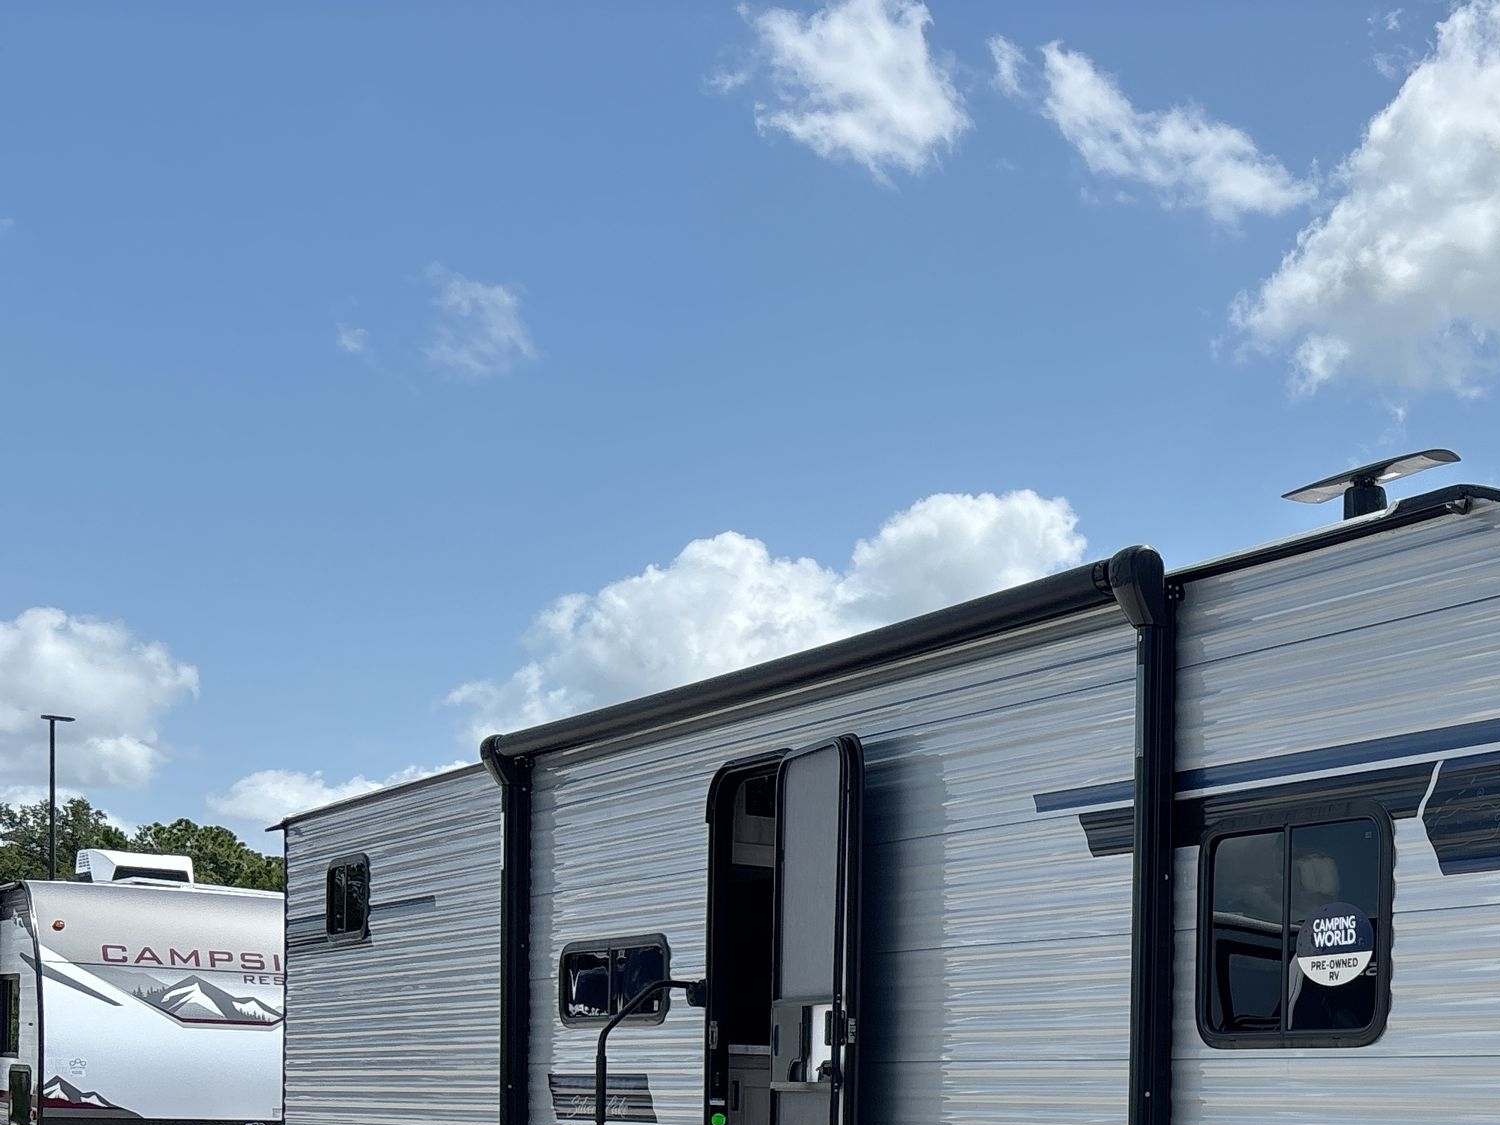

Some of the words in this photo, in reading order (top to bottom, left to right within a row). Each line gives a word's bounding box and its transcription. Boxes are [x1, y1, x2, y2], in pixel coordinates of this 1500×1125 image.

[1312, 915, 1356, 933] CAMPING
[1313, 929, 1357, 948] WORLD
[101, 944, 282, 972] CAMPSI
[1310, 957, 1359, 971] PRE-OWNED
[243, 975, 285, 986] RES
[1328, 971, 1340, 981] RV
